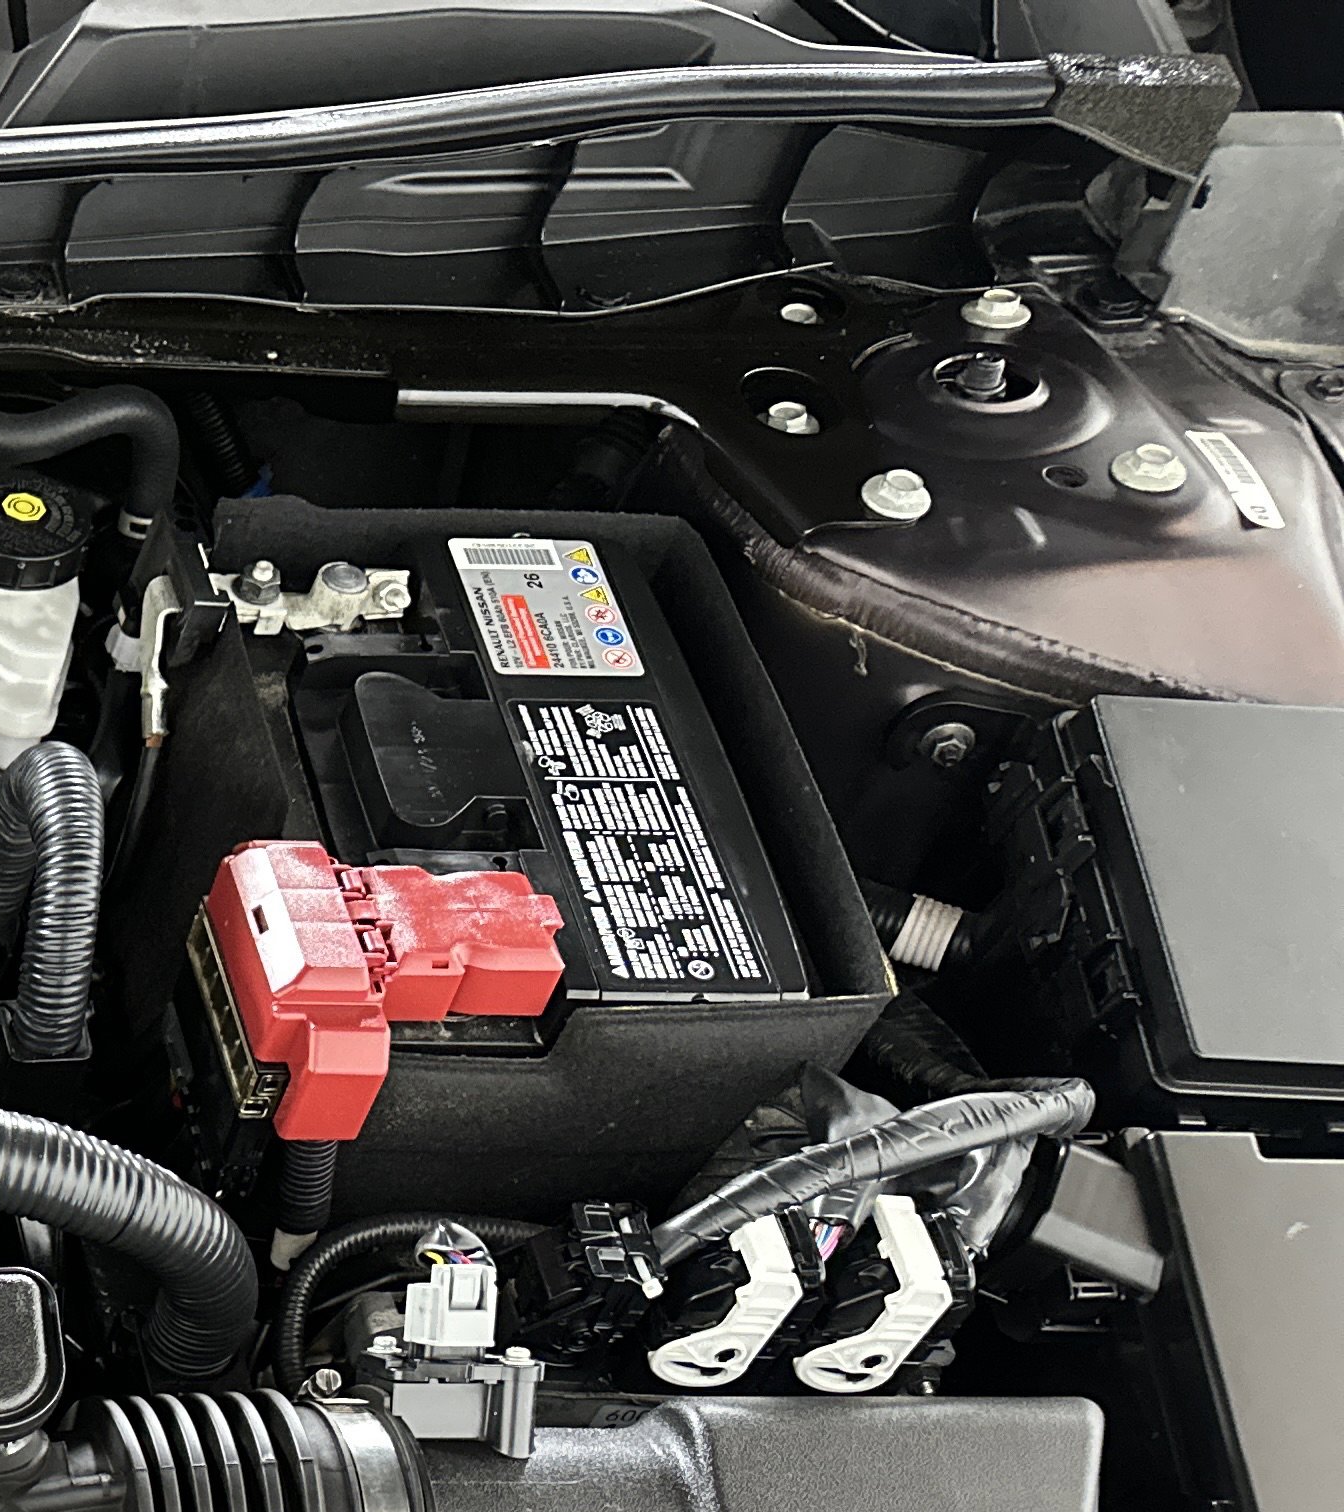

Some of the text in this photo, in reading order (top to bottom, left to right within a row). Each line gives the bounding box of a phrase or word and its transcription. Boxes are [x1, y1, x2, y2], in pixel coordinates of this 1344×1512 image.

[523, 573, 544, 589] 26
[473, 587, 510, 668] RENAULT NISSAN
[545, 643, 565, 668] 24410
